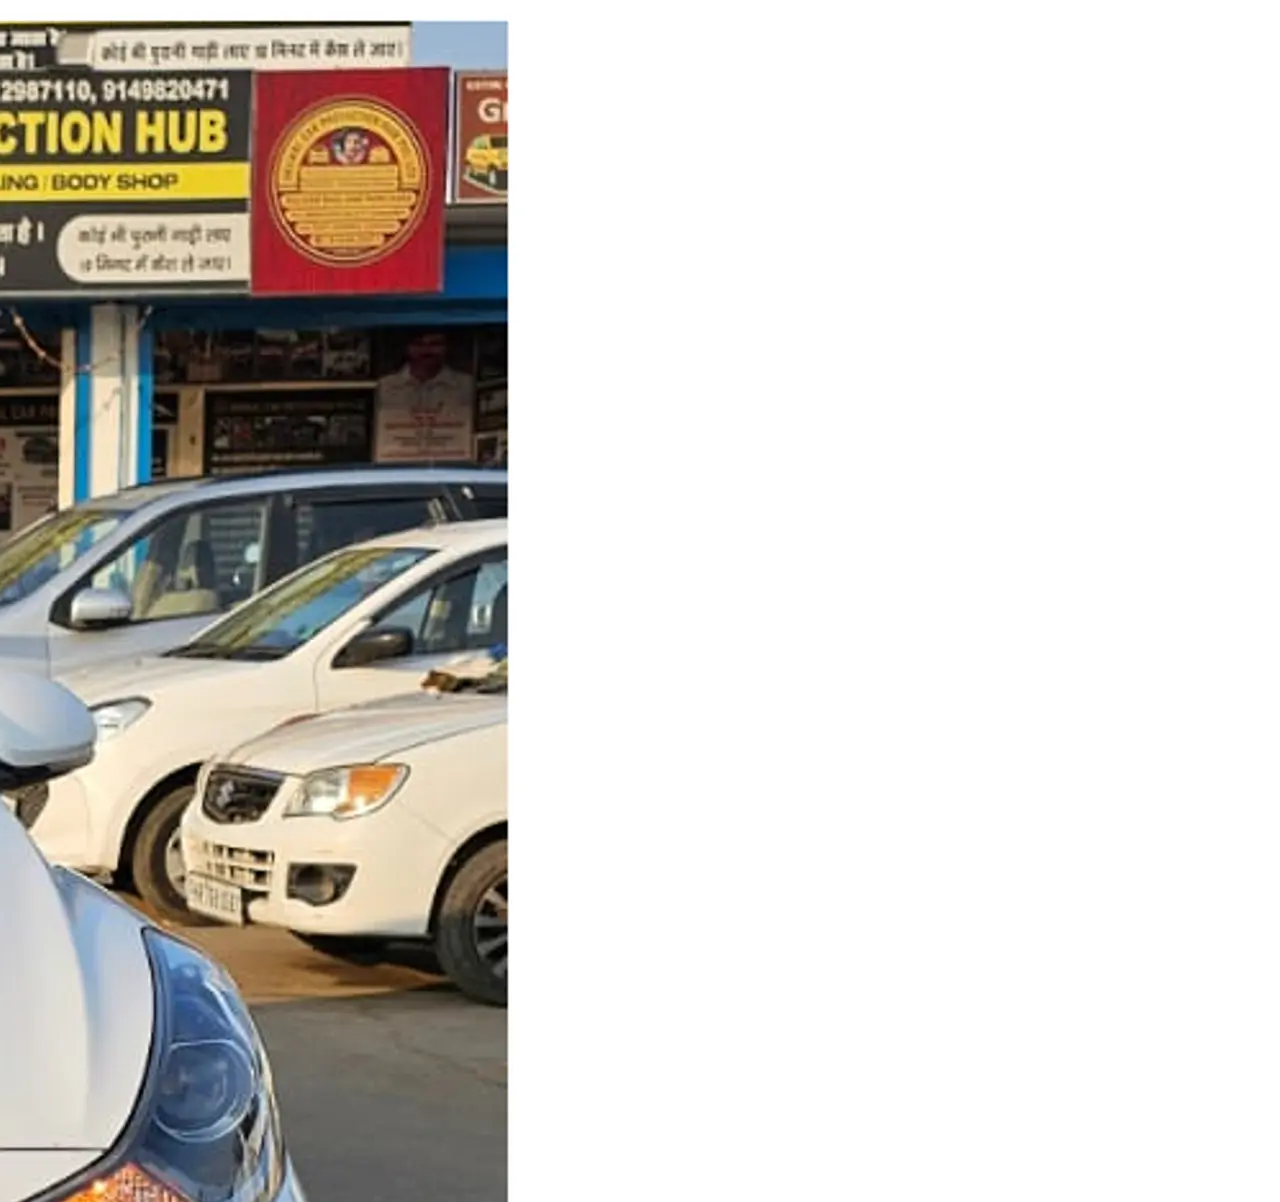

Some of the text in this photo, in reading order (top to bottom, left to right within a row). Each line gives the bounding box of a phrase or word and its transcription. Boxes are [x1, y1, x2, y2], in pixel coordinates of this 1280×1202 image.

[102, 78, 230, 101] 9149820471
[135, 108, 228, 154] HUB
[51, 173, 111, 192] BODY
[116, 172, 180, 191] SHOP
